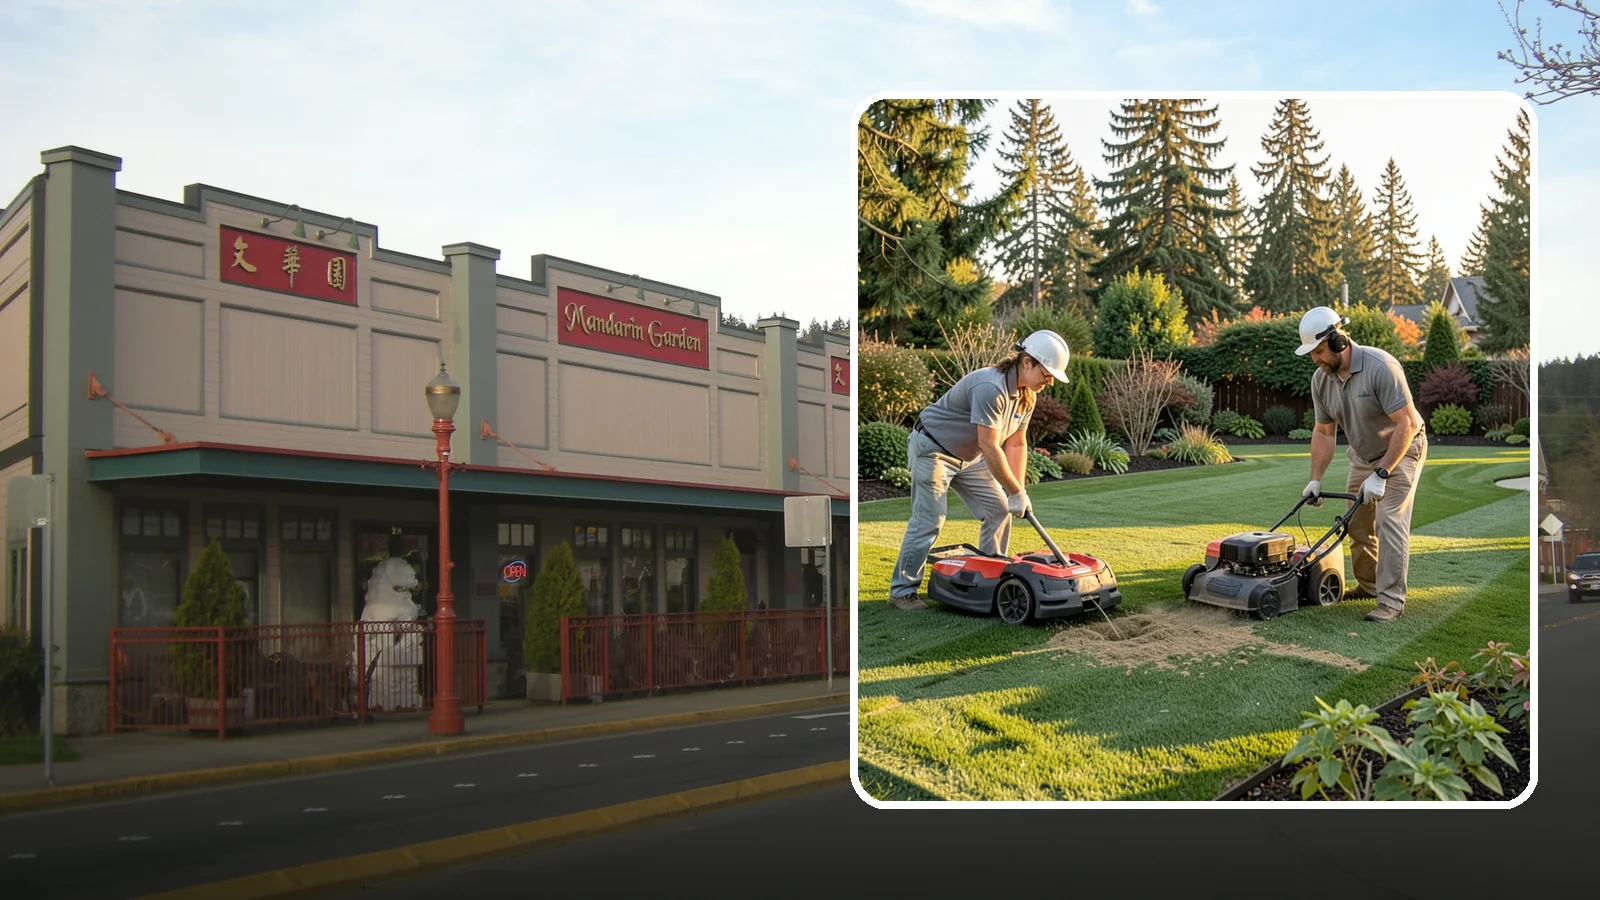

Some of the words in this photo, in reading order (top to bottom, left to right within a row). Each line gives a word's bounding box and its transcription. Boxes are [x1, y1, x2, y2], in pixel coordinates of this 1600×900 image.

[230, 235, 346, 291] 文華園
[564, 302, 644, 341] Mandarin
[648, 320, 702, 352] Garden
[503, 565, 527, 578] OPEN
